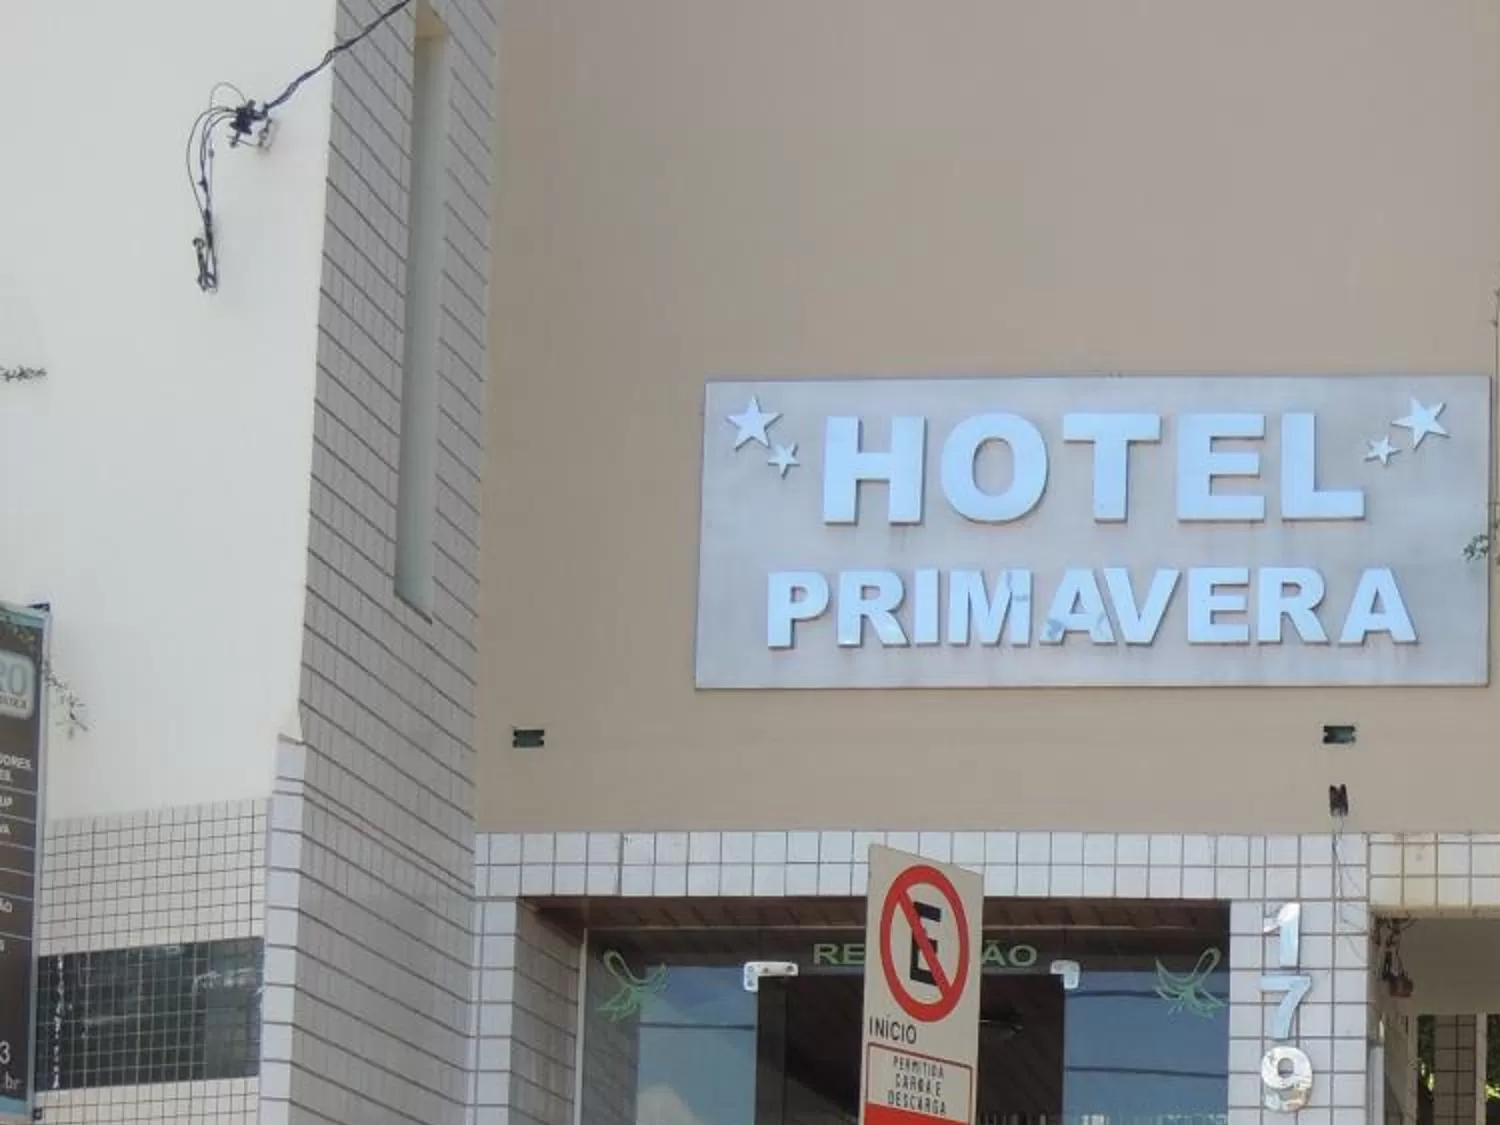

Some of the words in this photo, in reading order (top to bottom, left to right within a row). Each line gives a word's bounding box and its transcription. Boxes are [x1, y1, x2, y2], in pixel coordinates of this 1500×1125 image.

[822, 411, 1366, 524] HOTEL
[767, 567, 1420, 649] PRIMAVERA
[869, 1014, 917, 1045] INÍCIO
[893, 1056, 945, 1078] PERMITIDA
[896, 1073, 932, 1093] CARGA
[887, 1089, 947, 1115] DESCARGA
